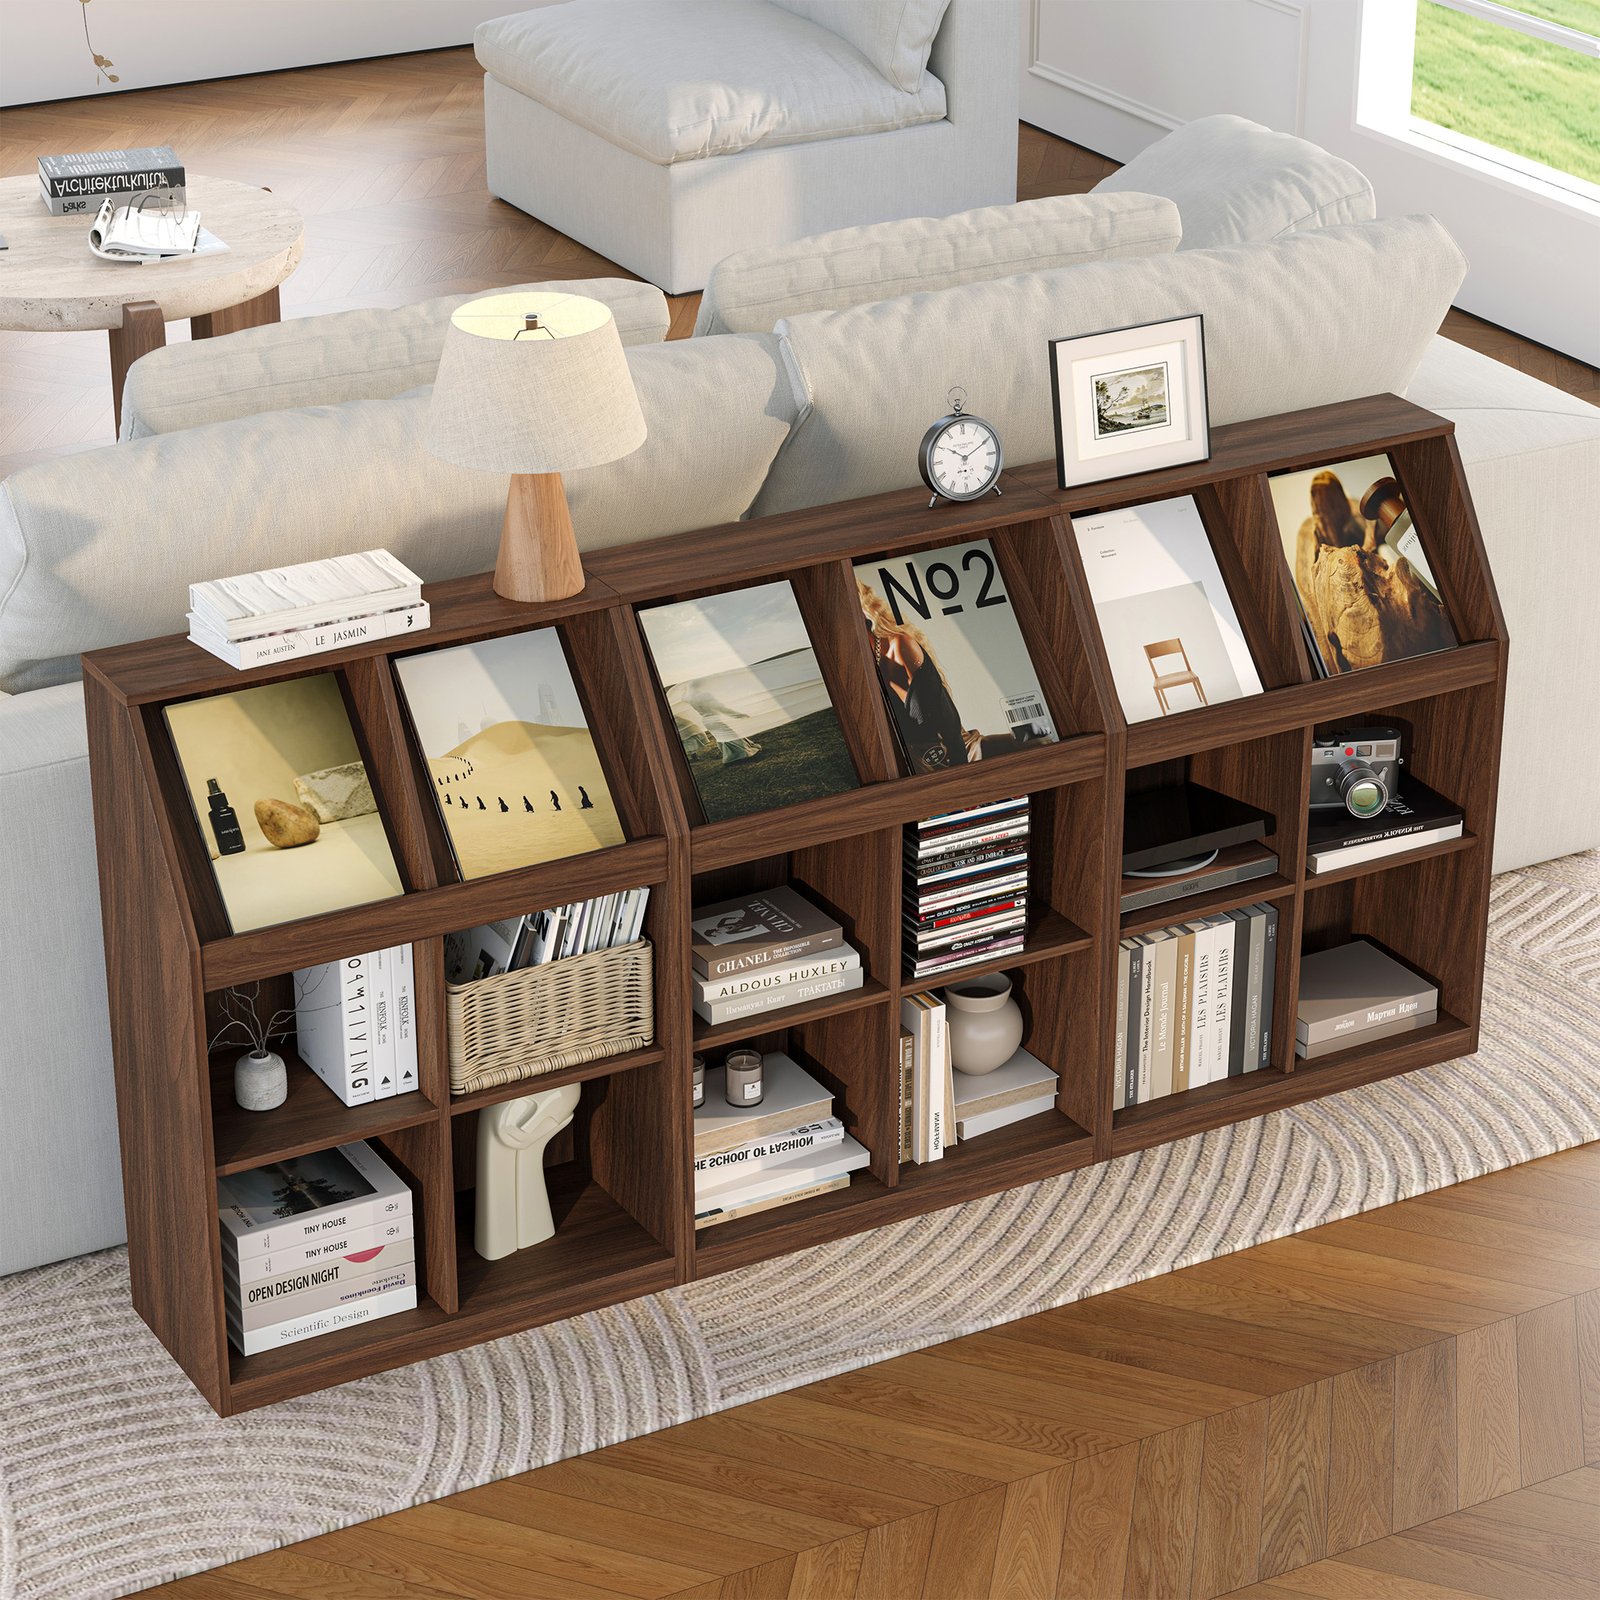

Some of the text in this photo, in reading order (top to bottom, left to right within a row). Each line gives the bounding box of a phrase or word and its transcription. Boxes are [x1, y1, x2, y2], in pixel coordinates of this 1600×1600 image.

[256, 625, 368, 660] JANE AUSTEN LE JASMIN
[716, 951, 771, 975] CHANEL
[1217, 947, 1230, 999] PLAISIRS
[720, 960, 849, 997] ALDOUS HUXLEY
[797, 978, 846, 998] ТРАКТАТЫ
[1144, 960, 1152, 994] Handbook
[1198, 954, 1209, 1005] PLAISIRS
[378, 1001, 387, 1031] KINFOLK
[400, 995, 409, 1026] KINFOLK
[1144, 994, 1152, 1016] Design
[1158, 982, 1170, 1052] Le Monde Journal
[1196, 1008, 1207, 1029] LES
[1215, 1002, 1226, 1023] LES
[1367, 1001, 1418, 1023] Мартин Иден
[1142, 1016, 1150, 1040] Interior
[304, 1216, 347, 1235] TINY HOUSE
[305, 1240, 348, 1259] TINY HOUSE
[248, 1266, 340, 1303] OPEN DESIGN NIGHT
[383, 1279, 406, 1290] David
[280, 1308, 369, 1340] Scientific Design
